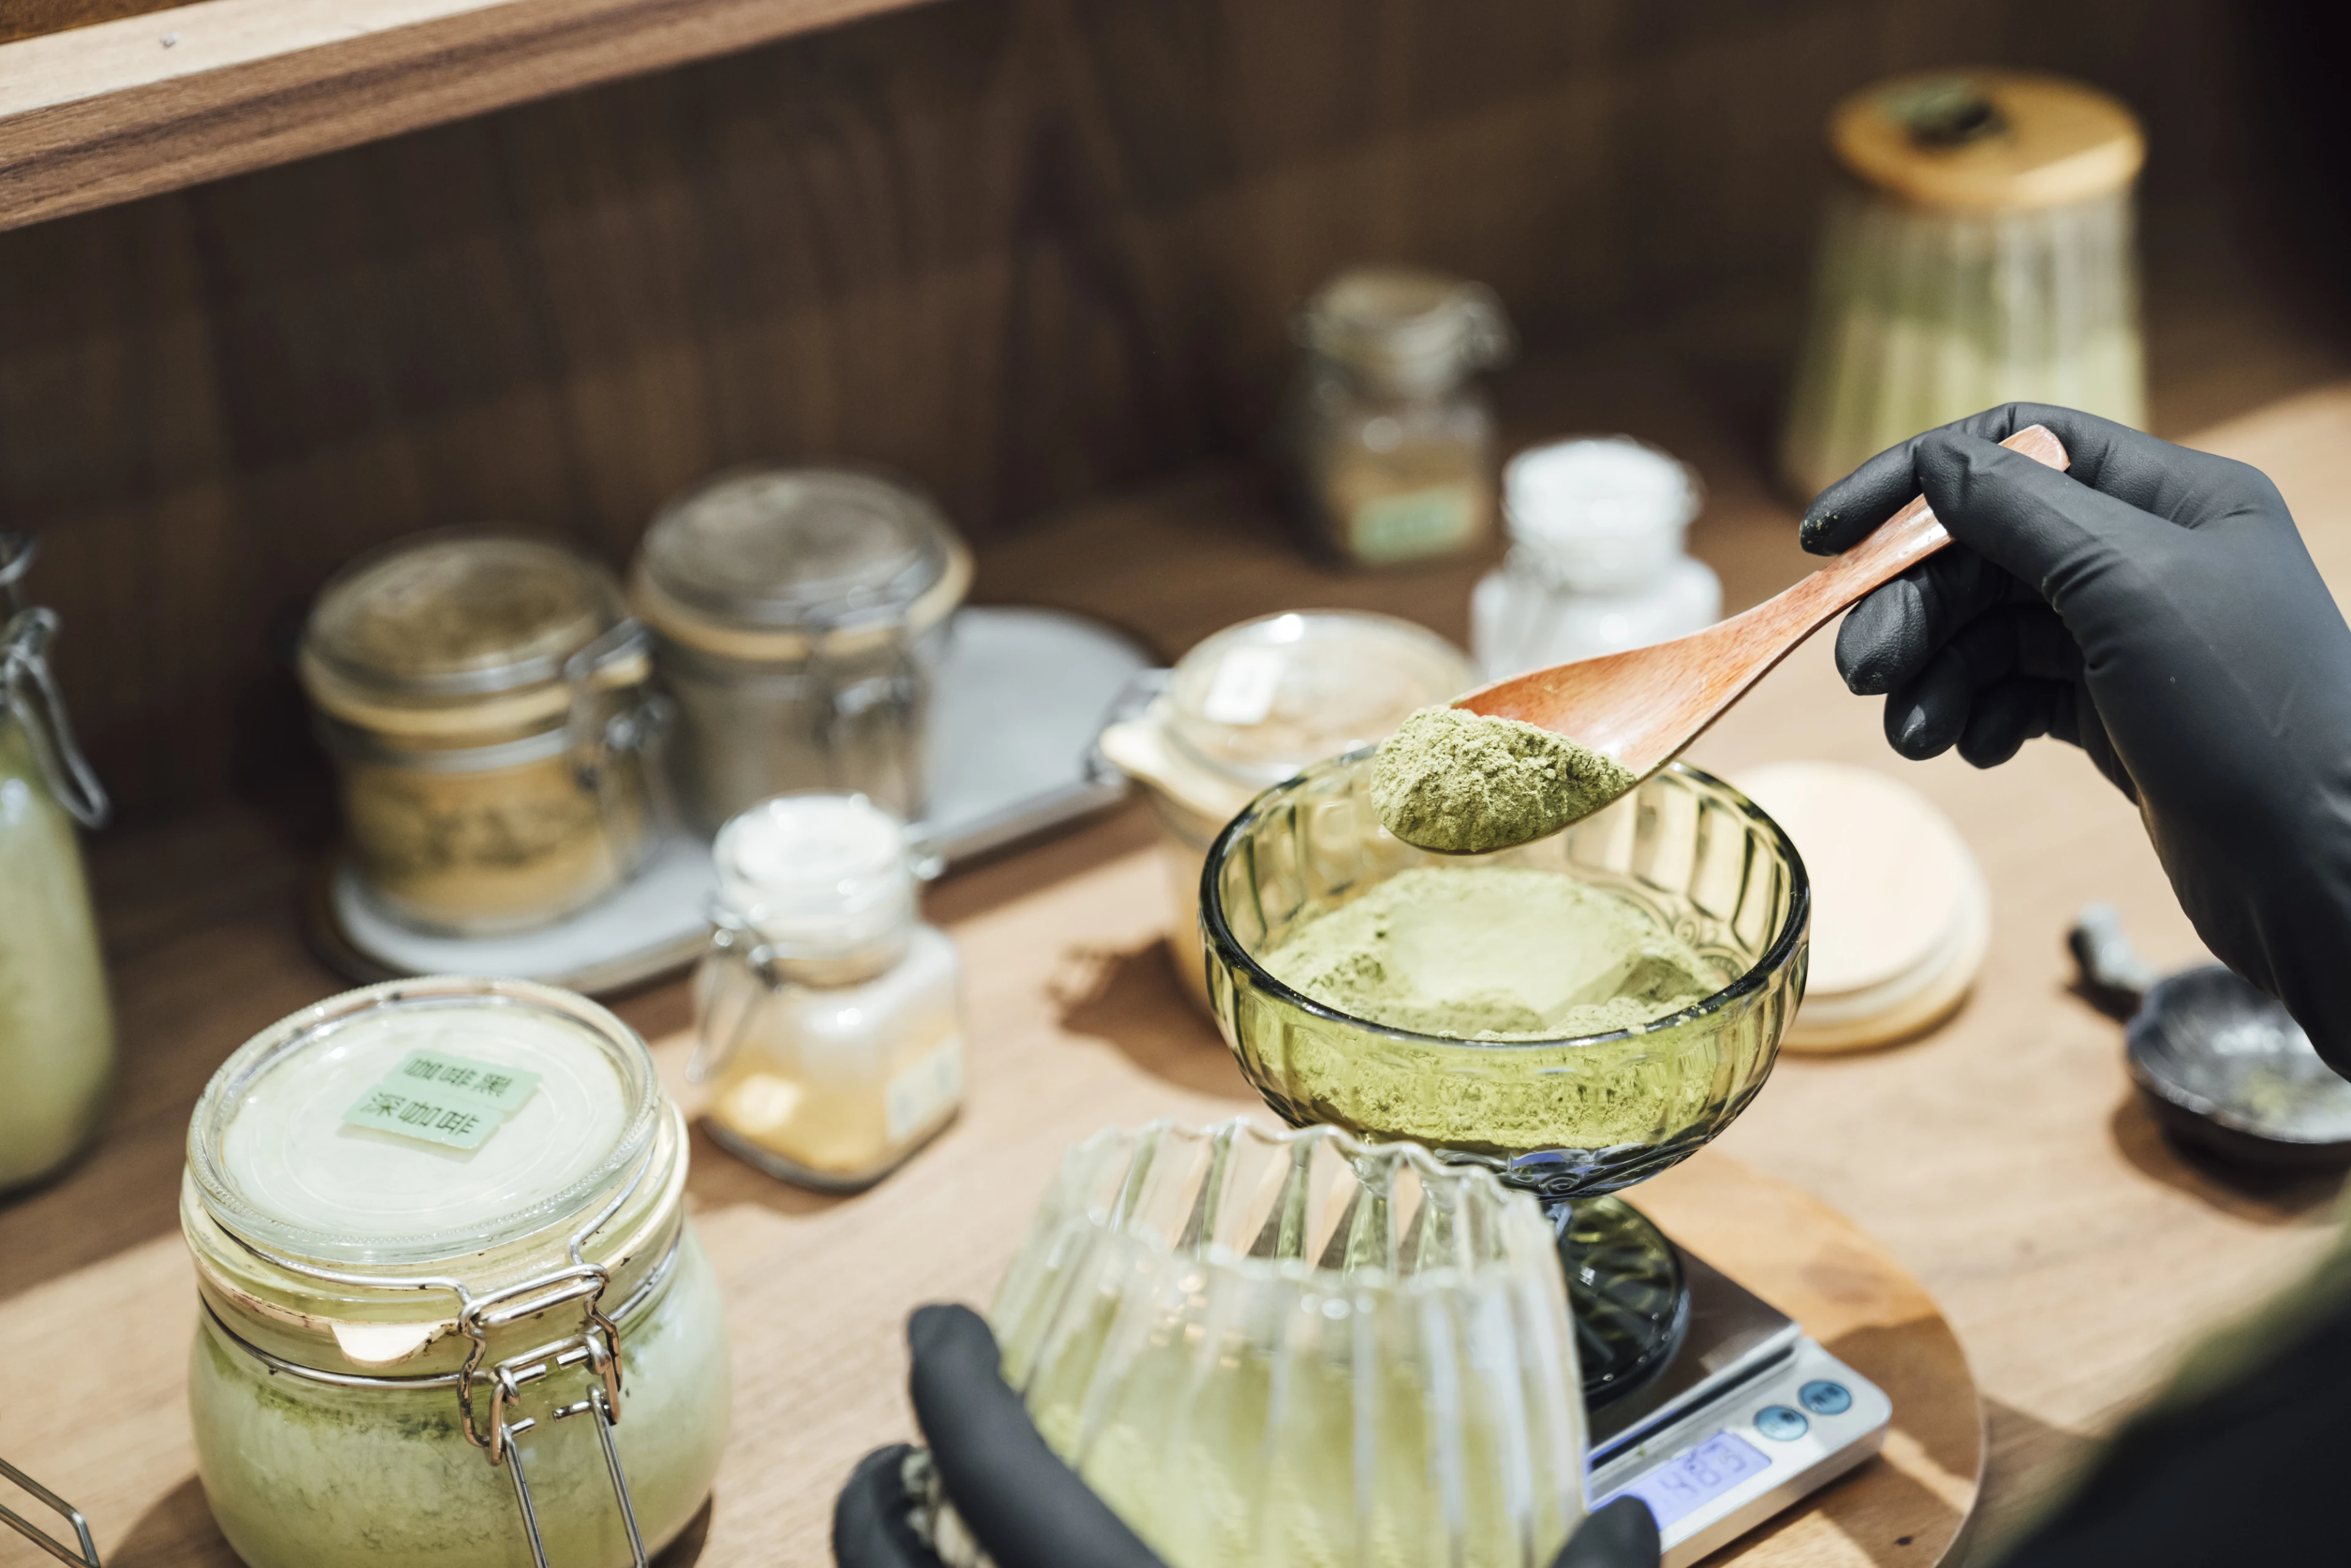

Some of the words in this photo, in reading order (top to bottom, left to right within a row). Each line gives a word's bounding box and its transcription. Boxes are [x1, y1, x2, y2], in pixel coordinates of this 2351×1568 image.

[403, 1058, 513, 1097] 咖啡黑
[359, 1092, 480, 1135] 深咖啡
